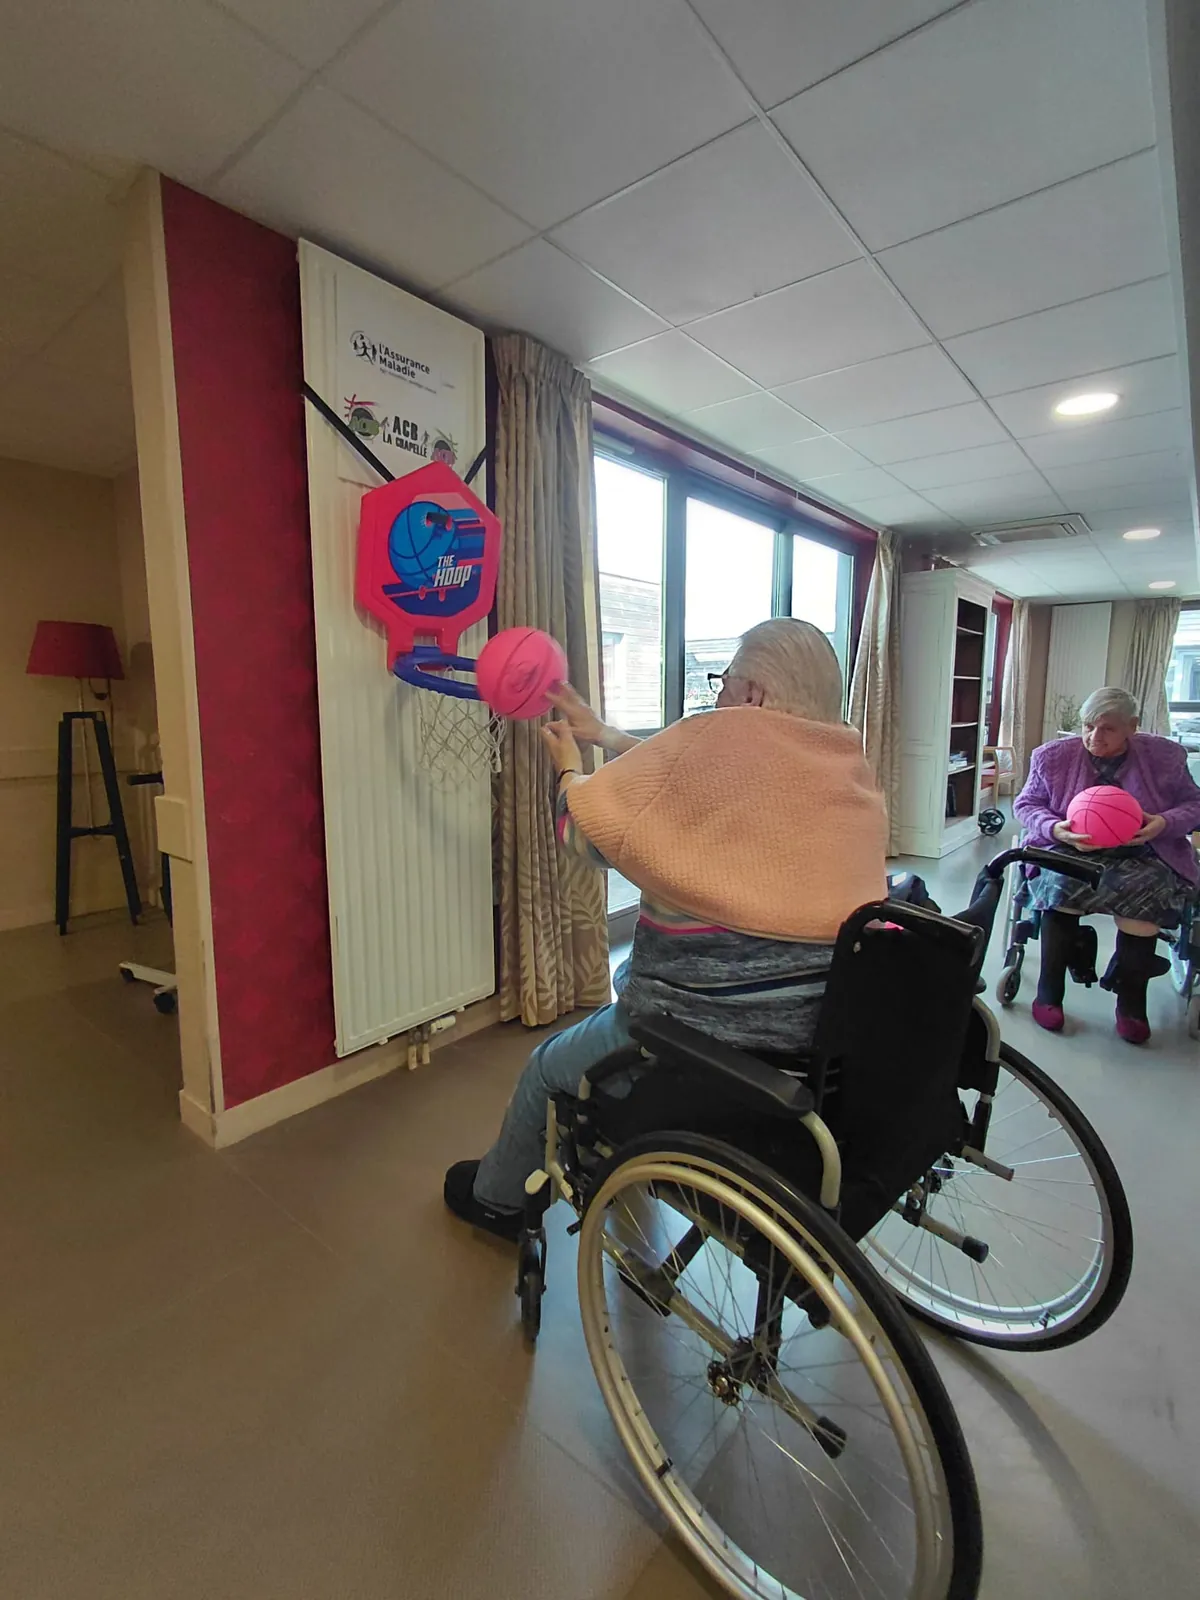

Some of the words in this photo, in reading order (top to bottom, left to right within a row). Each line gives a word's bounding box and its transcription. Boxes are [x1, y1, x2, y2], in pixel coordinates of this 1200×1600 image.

[379, 343, 430, 374] l'Assurance
[379, 355, 416, 379] Maladie
[382, 432, 392, 445] LA
[392, 415, 419, 441] ACB
[437, 554, 455, 568] THE
[433, 564, 473, 588] HOOP
